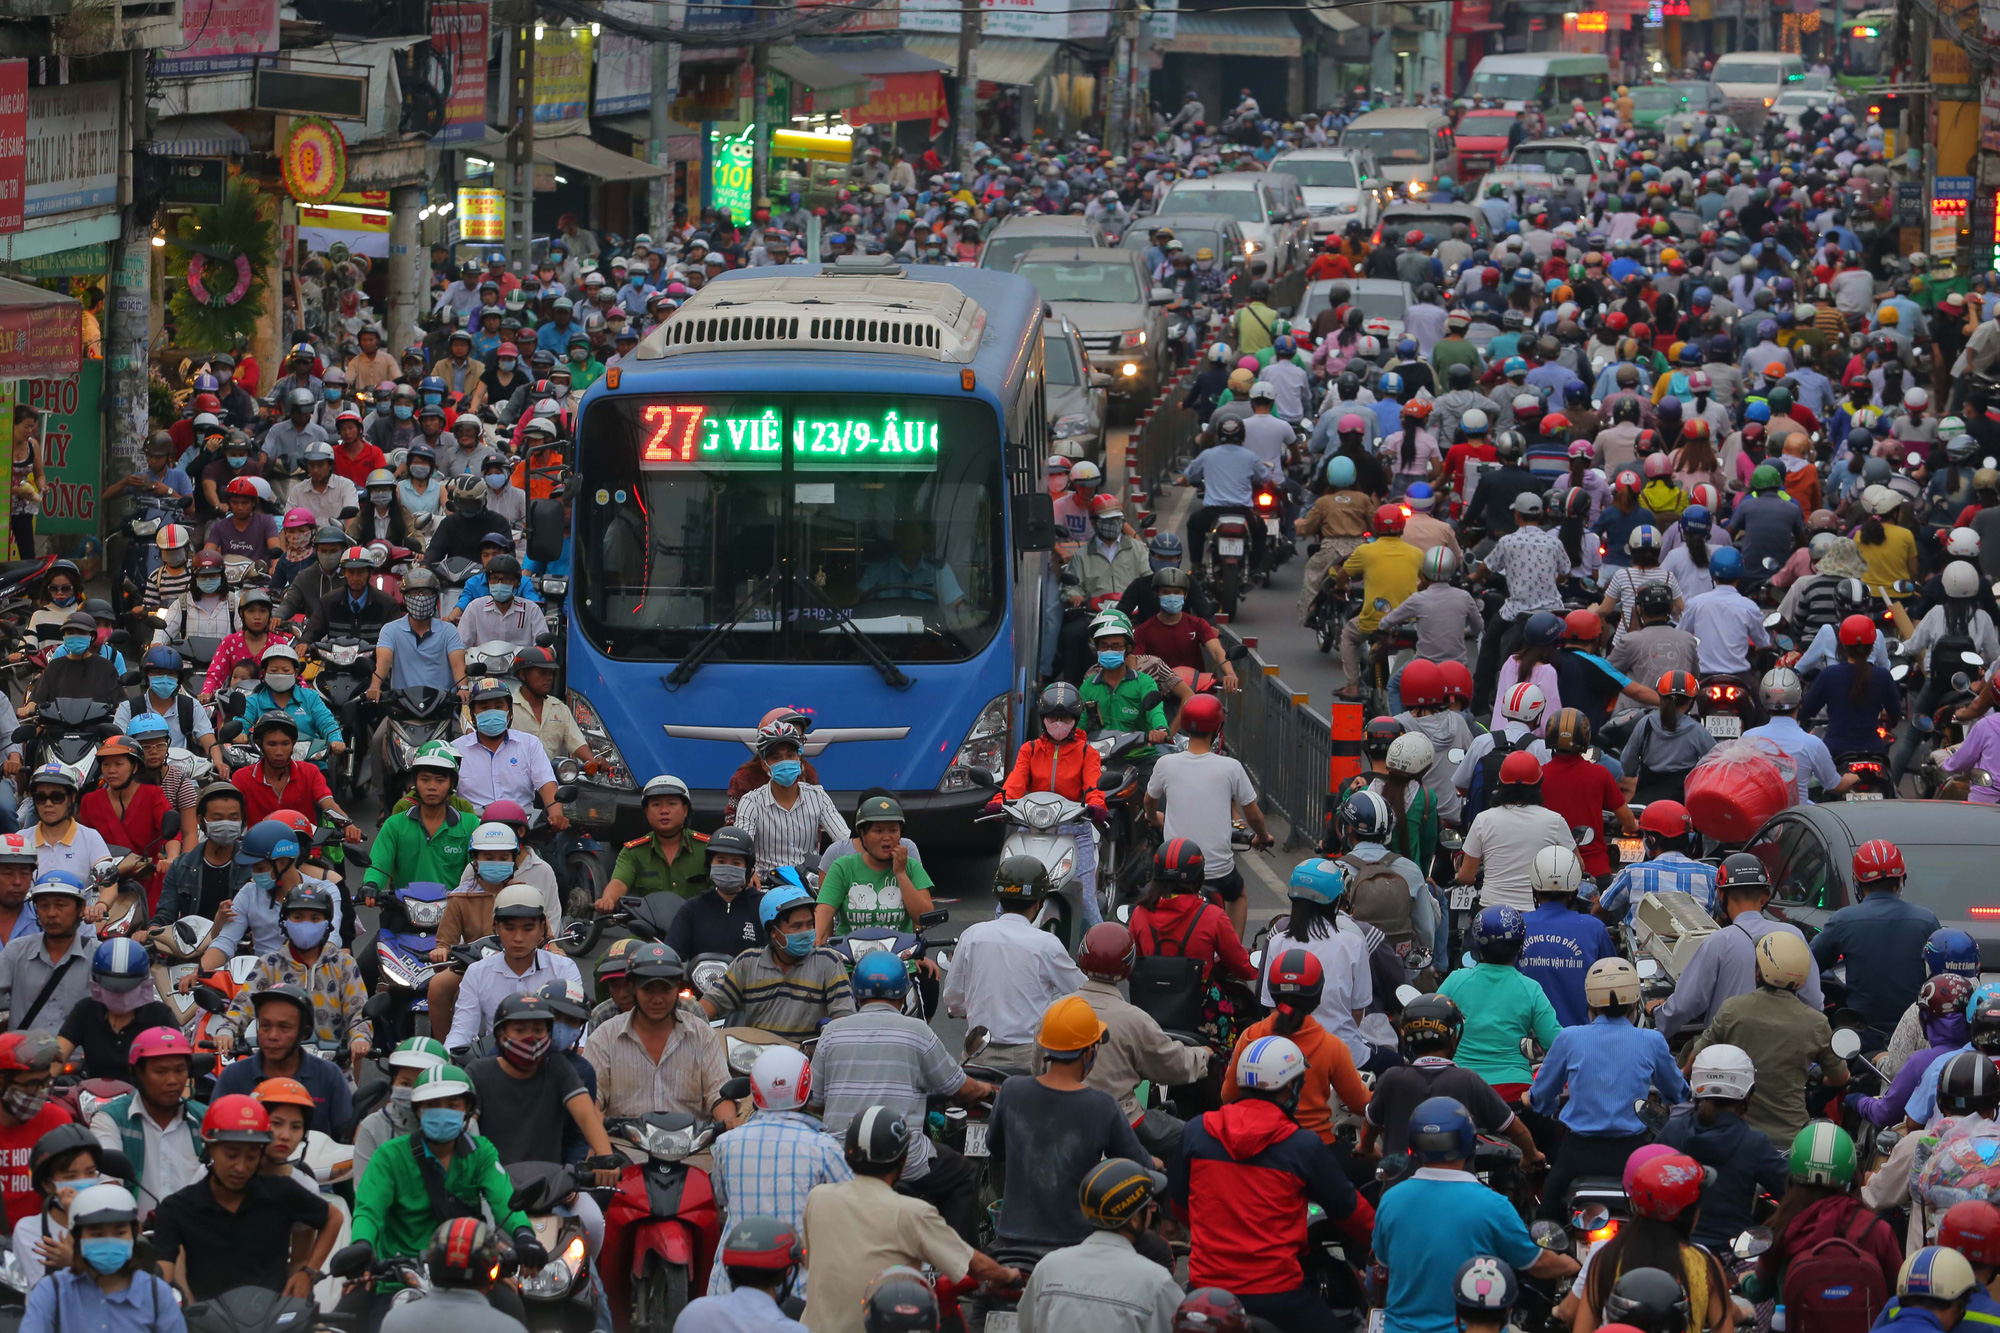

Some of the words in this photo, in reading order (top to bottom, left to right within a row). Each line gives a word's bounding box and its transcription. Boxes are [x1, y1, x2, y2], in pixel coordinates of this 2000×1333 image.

[62, 325, 78, 337] SG
[644, 405, 704, 461] 27
[810, 411, 925, 455] 23/9-ÂU
[42, 477, 94, 519] ƠNG
[1122, 706, 1139, 716] Grab
[276, 844, 294, 853] UBER
[444, 845, 463, 854] Grab
[1620, 851, 1642, 861] 5.57
[1456, 897, 1471, 908] 78
[847, 911, 873, 923] LINE
[876, 911, 906, 922] WITH
[1520, 934, 1546, 954] ƯỜNG
[1546, 934, 1561, 944] CAO
[1529, 956, 1551, 967] THÔNG
[1551, 957, 1564, 969] VẬN
[1565, 956, 1576, 968] TẢI
[1576, 959, 1584, 968] III
[1111, 1185, 1146, 1215] STANLEY
[1824, 1288, 1850, 1296] SAMSUNG
